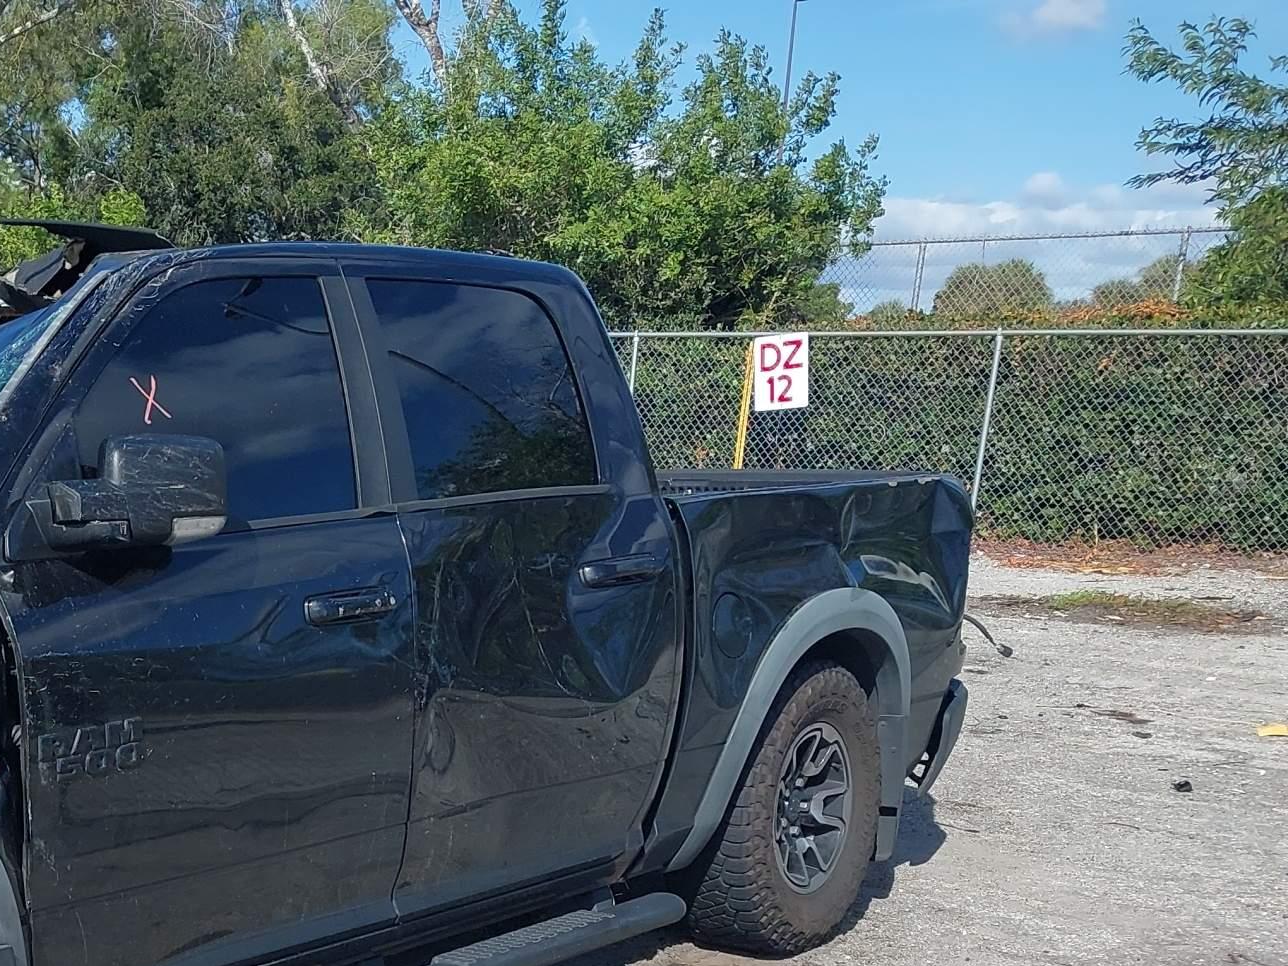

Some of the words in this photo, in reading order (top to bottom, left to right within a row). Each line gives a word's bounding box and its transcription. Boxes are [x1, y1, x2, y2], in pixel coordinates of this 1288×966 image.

[760, 339, 803, 372] DZ
[766, 374, 792, 403] 12
[37, 716, 143, 764] RAM
